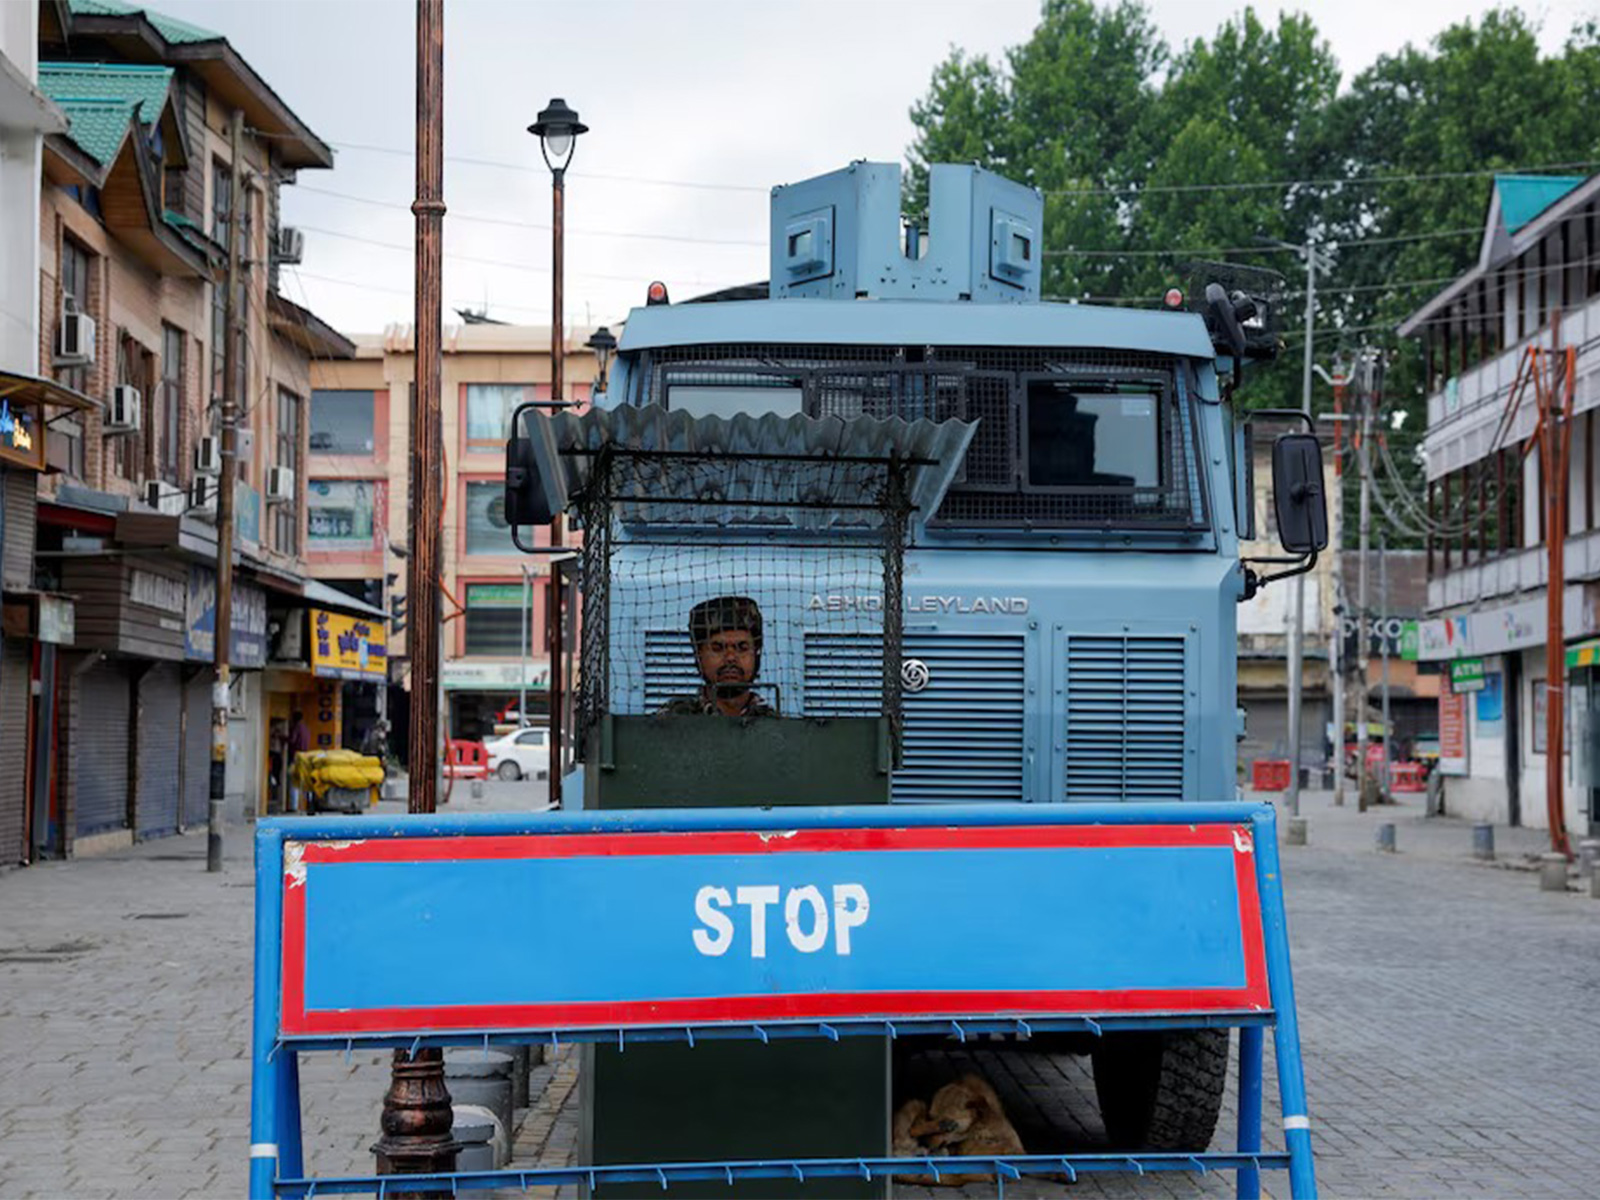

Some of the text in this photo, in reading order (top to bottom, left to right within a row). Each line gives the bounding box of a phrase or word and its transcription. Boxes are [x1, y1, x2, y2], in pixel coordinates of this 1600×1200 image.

[808, 595, 1029, 614] ASHO LEYLAND
[1453, 663, 1483, 678] ATM
[692, 883, 871, 959] STOP
